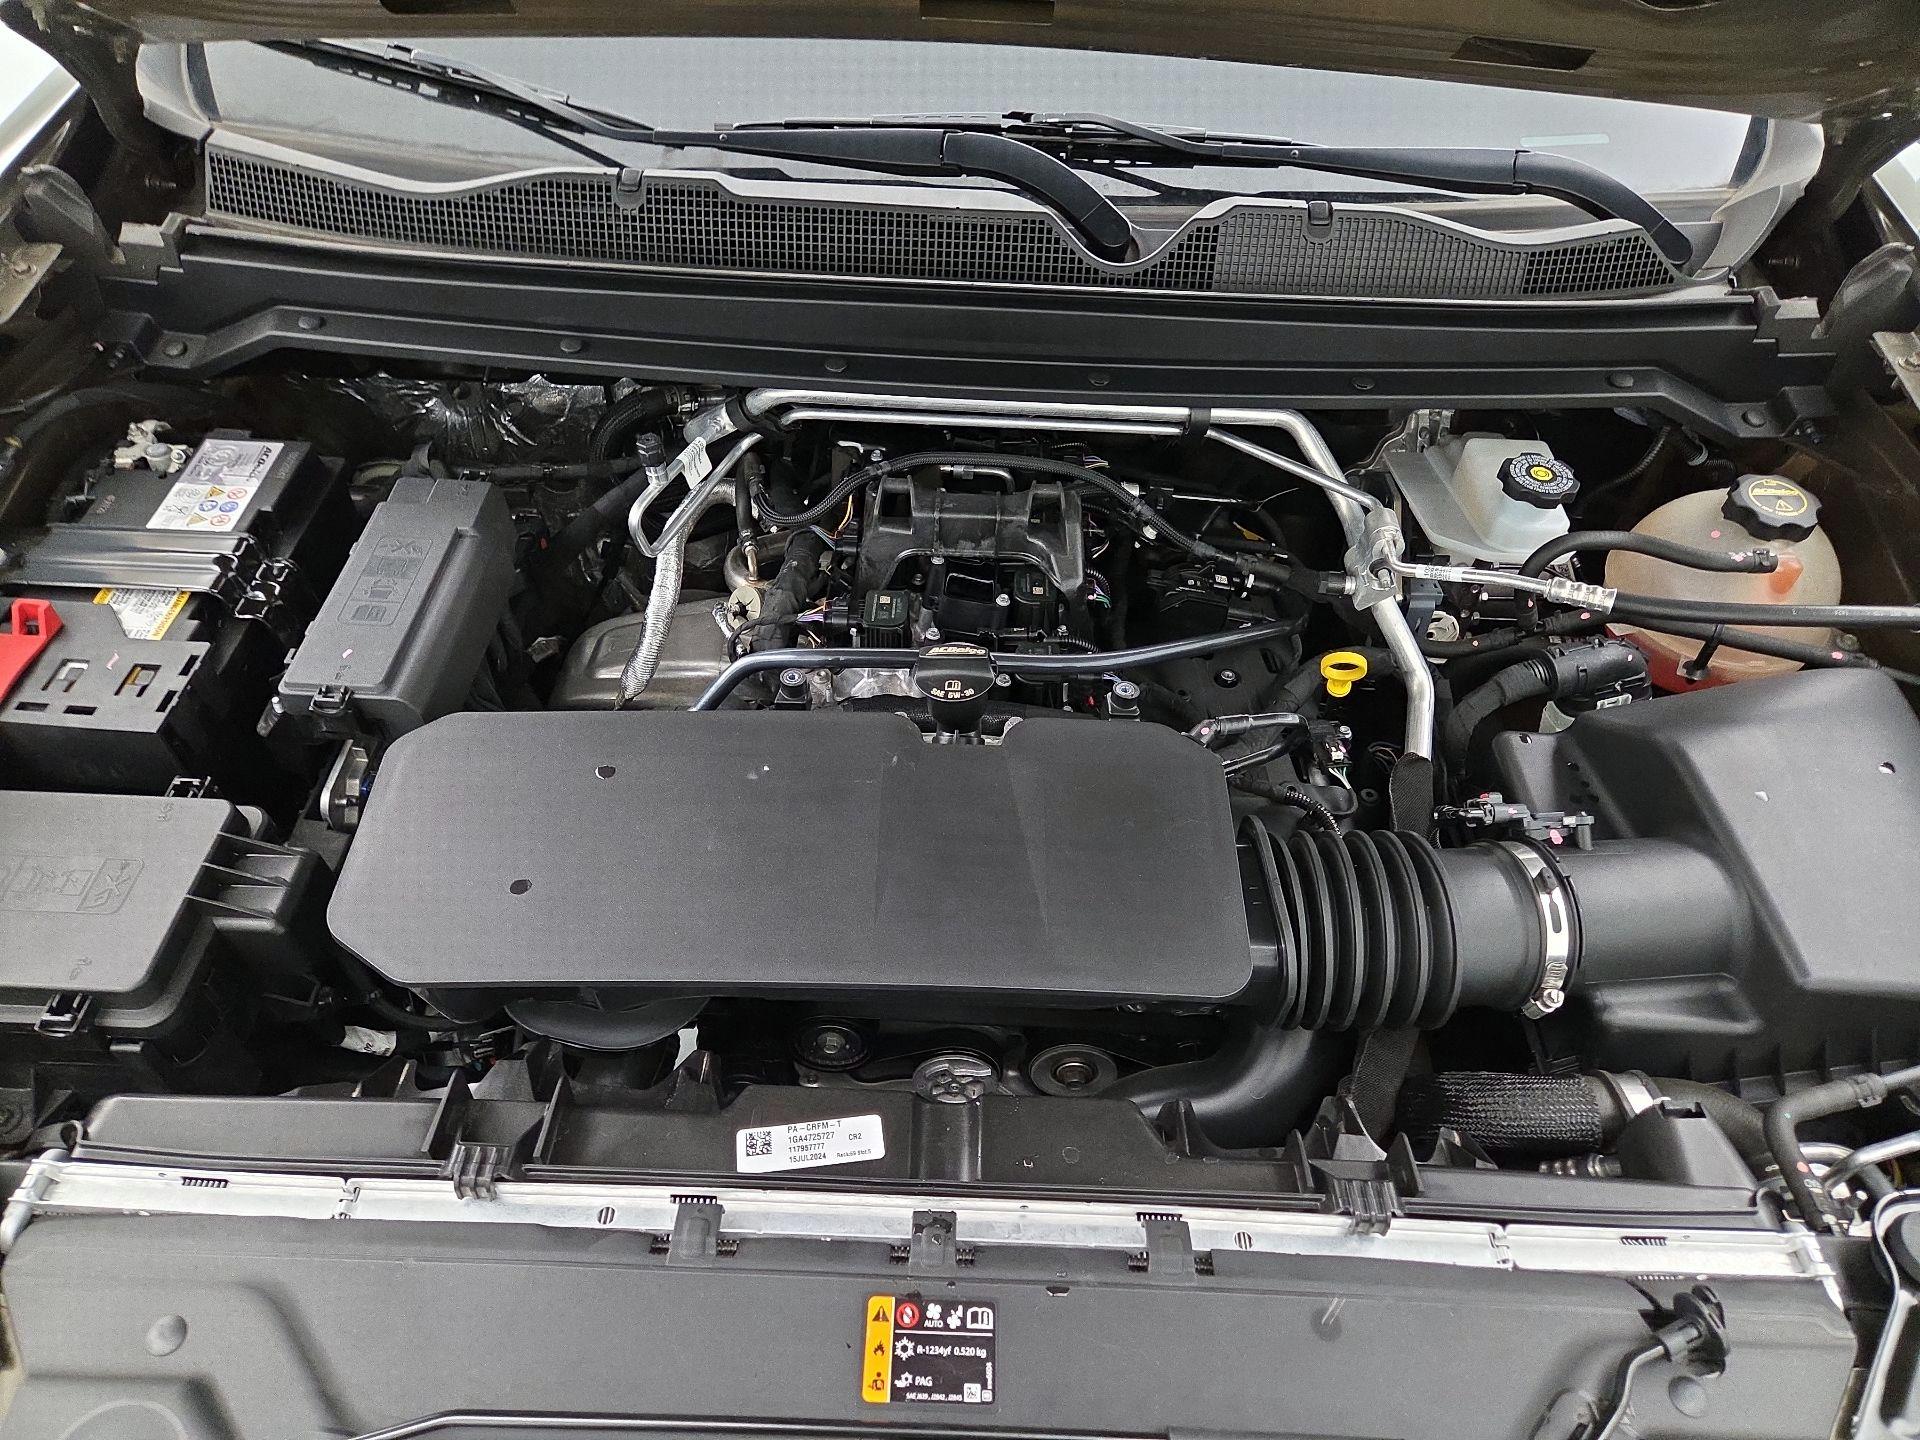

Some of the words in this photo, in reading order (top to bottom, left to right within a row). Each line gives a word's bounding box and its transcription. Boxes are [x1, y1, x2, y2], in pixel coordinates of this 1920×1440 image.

[931, 688, 945, 697] SAE
[788, 1132, 834, 1143] 1GA4725727
[848, 1133, 862, 1141] CR2
[789, 1153, 826, 1163] 15JUL2024
[924, 1320, 943, 1328] AUTO
[917, 1345, 951, 1357] R-1234yf
[954, 1347, 975, 1356] 0.520
[976, 1347, 986, 1358] kg
[915, 1377, 933, 1386] PAG
